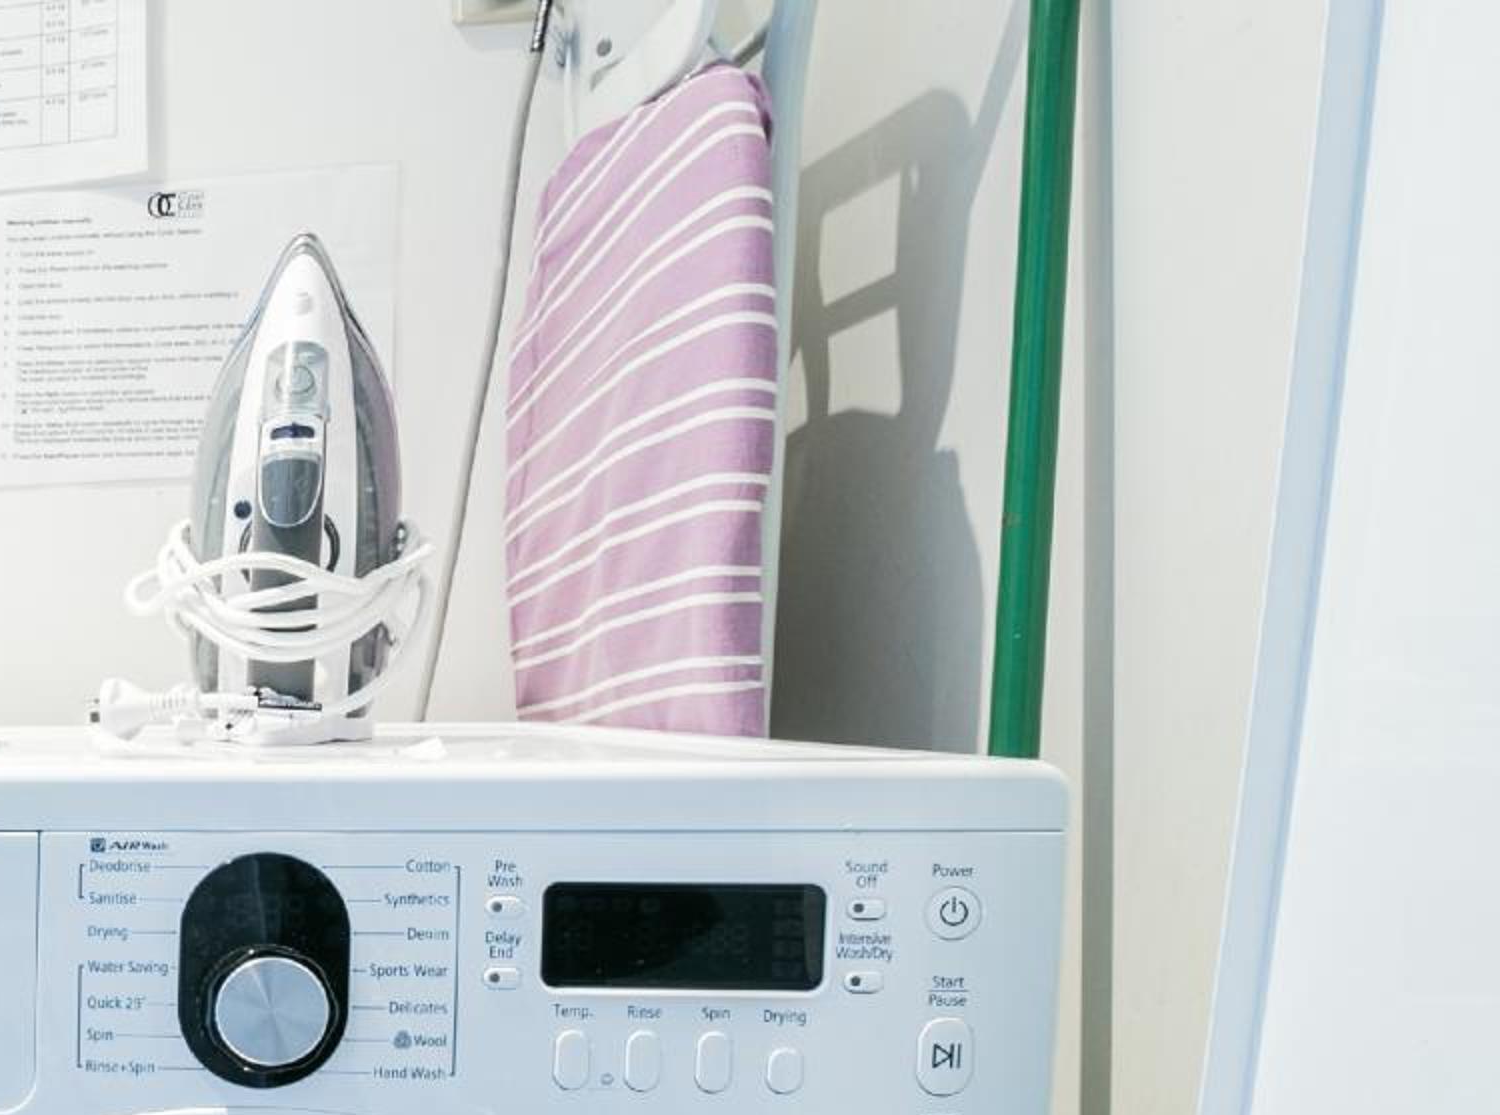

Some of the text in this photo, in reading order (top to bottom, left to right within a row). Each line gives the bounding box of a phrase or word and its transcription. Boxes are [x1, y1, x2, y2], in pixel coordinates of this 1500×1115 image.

[89, 859, 150, 872] Deodorise
[405, 859, 450, 872] Cotton
[494, 860, 517, 873] Pre
[845, 860, 889, 874] Sound
[932, 864, 974, 878] Power
[487, 874, 523, 888] Wash
[856, 875, 879, 888] Off
[88, 891, 137, 904] Sanitise
[384, 893, 450, 908] Synthetics
[87, 925, 128, 941] Drying
[407, 927, 449, 941] Denim
[485, 931, 521, 948] Delay
[839, 932, 892, 946] Intensive
[489, 945, 514, 959] End
[836, 945, 893, 962] Wash/Dry
[88, 960, 169, 976] Water Saving
[370, 964, 448, 980] Sports Wear
[932, 975, 965, 989] Start
[87, 996, 121, 1009] Quick
[389, 1001, 448, 1014] Delicates
[929, 993, 967, 1008] Pause
[554, 1005, 593, 1021] Temp.
[627, 1005, 662, 1019] Rinse
[701, 1006, 731, 1022] Spin
[763, 1009, 807, 1026] Drying
[86, 1027, 113, 1043] Spin
[414, 1034, 447, 1047] Wool
[373, 1066, 446, 1080] Hand Wash
